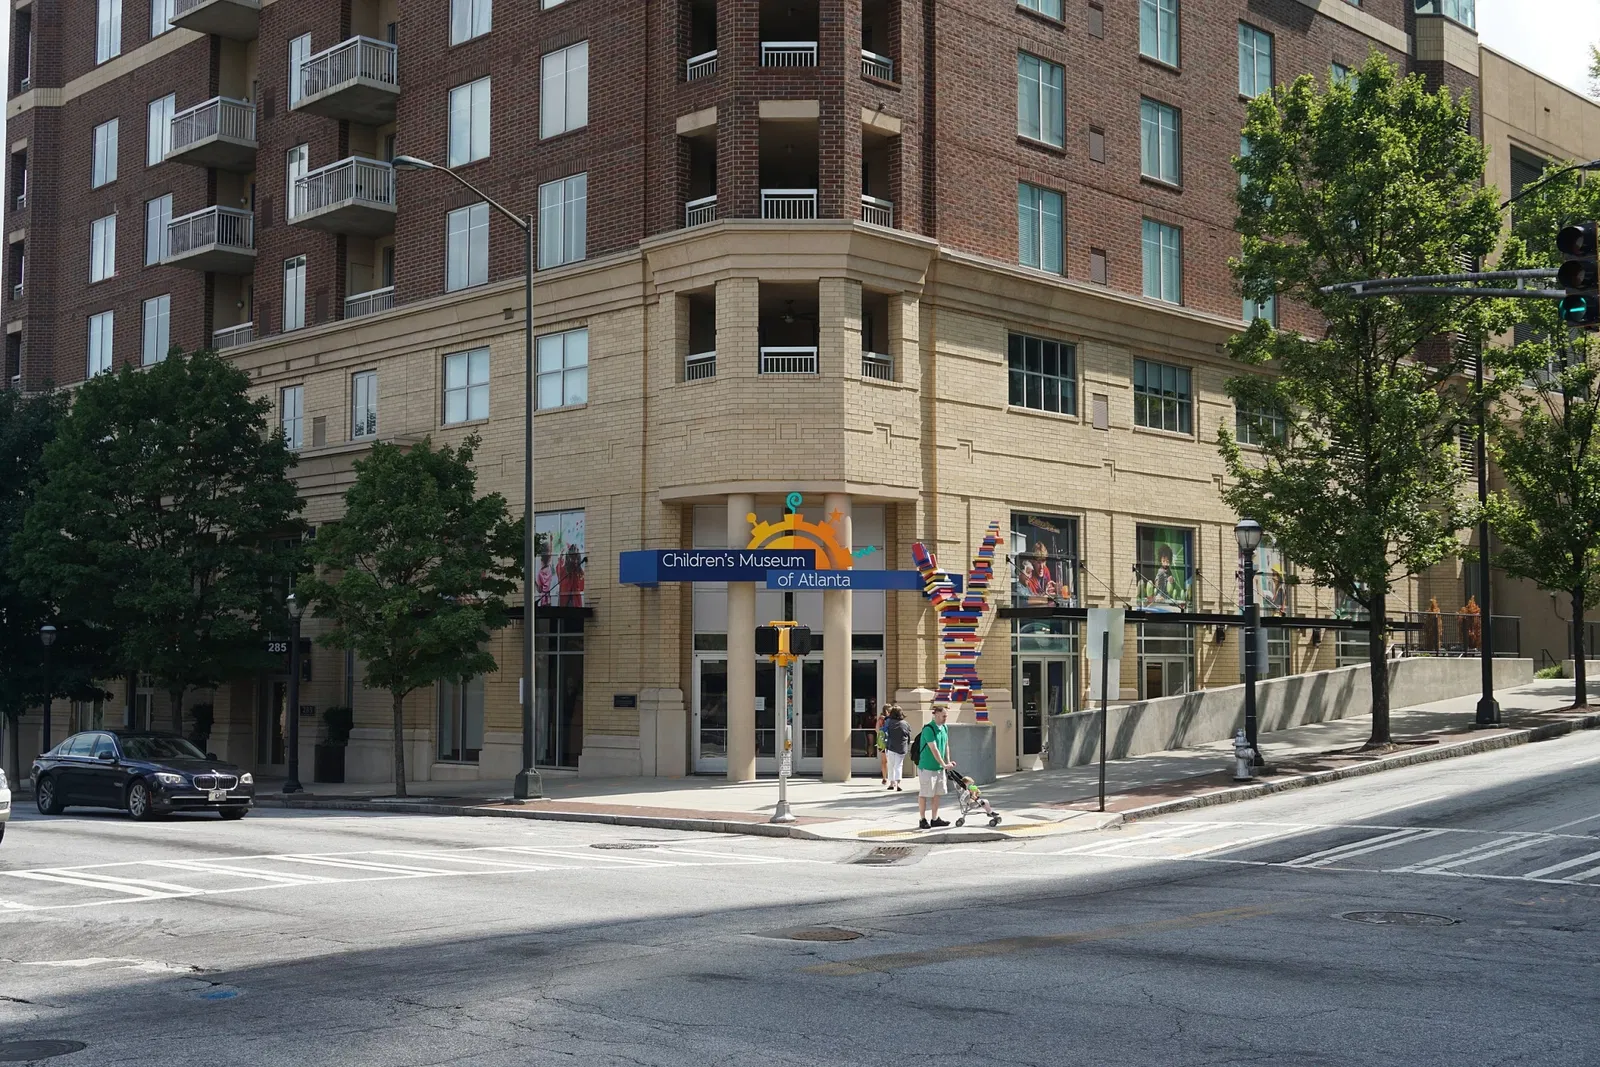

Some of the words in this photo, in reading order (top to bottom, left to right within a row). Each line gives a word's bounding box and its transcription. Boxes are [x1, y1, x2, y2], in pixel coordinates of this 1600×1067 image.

[662, 553, 735, 567] Children's
[739, 553, 806, 567] Museum
[777, 572, 794, 587] of
[798, 572, 851, 587] Atlanta
[268, 642, 287, 653] 285
